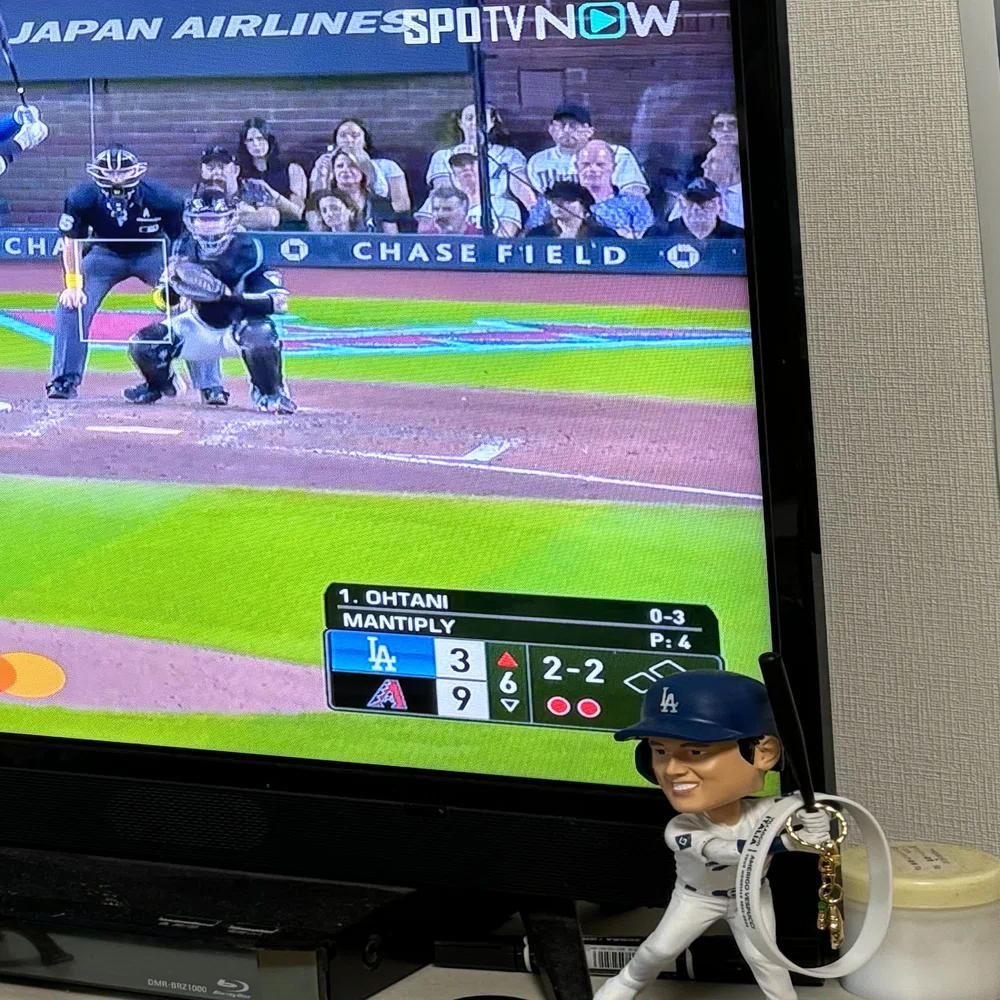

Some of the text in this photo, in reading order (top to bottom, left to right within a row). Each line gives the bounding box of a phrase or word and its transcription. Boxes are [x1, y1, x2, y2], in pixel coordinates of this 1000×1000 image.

[7, 9, 406, 45] JAPAN AIRLINES
[352, 241, 628, 266] CHASE FIELD
[338, 589, 449, 610] 1. OHTANI
[342, 612, 456, 634] MANTIPLY
[649, 608, 686, 625] 0-3
[450, 648, 470, 672] 3
[542, 655, 605, 684] 2-2
[499, 671, 517, 694] 6
[452, 685, 471, 711] 9
